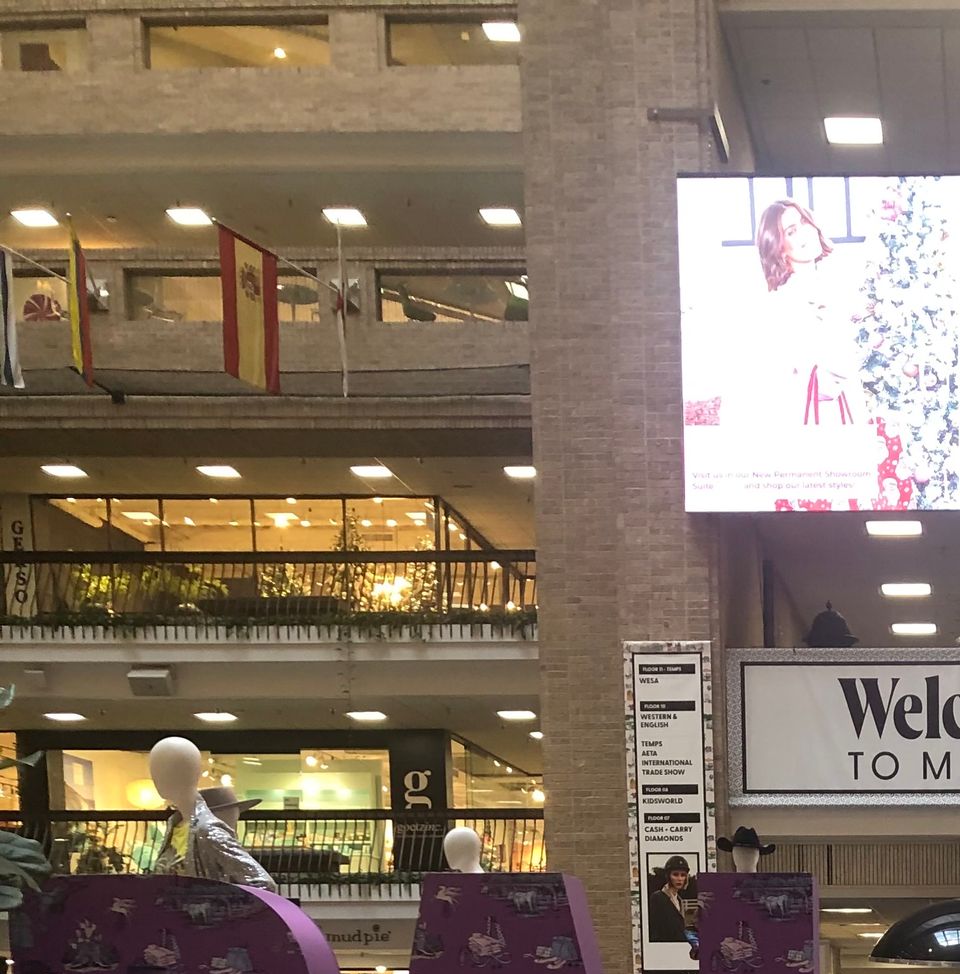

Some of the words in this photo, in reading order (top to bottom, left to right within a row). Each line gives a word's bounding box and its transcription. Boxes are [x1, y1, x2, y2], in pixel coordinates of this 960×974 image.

[762, 482, 783, 490] shop
[11, 520, 28, 604] GESO
[848, 751, 899, 780] TO
[404, 770, 432, 809] g
